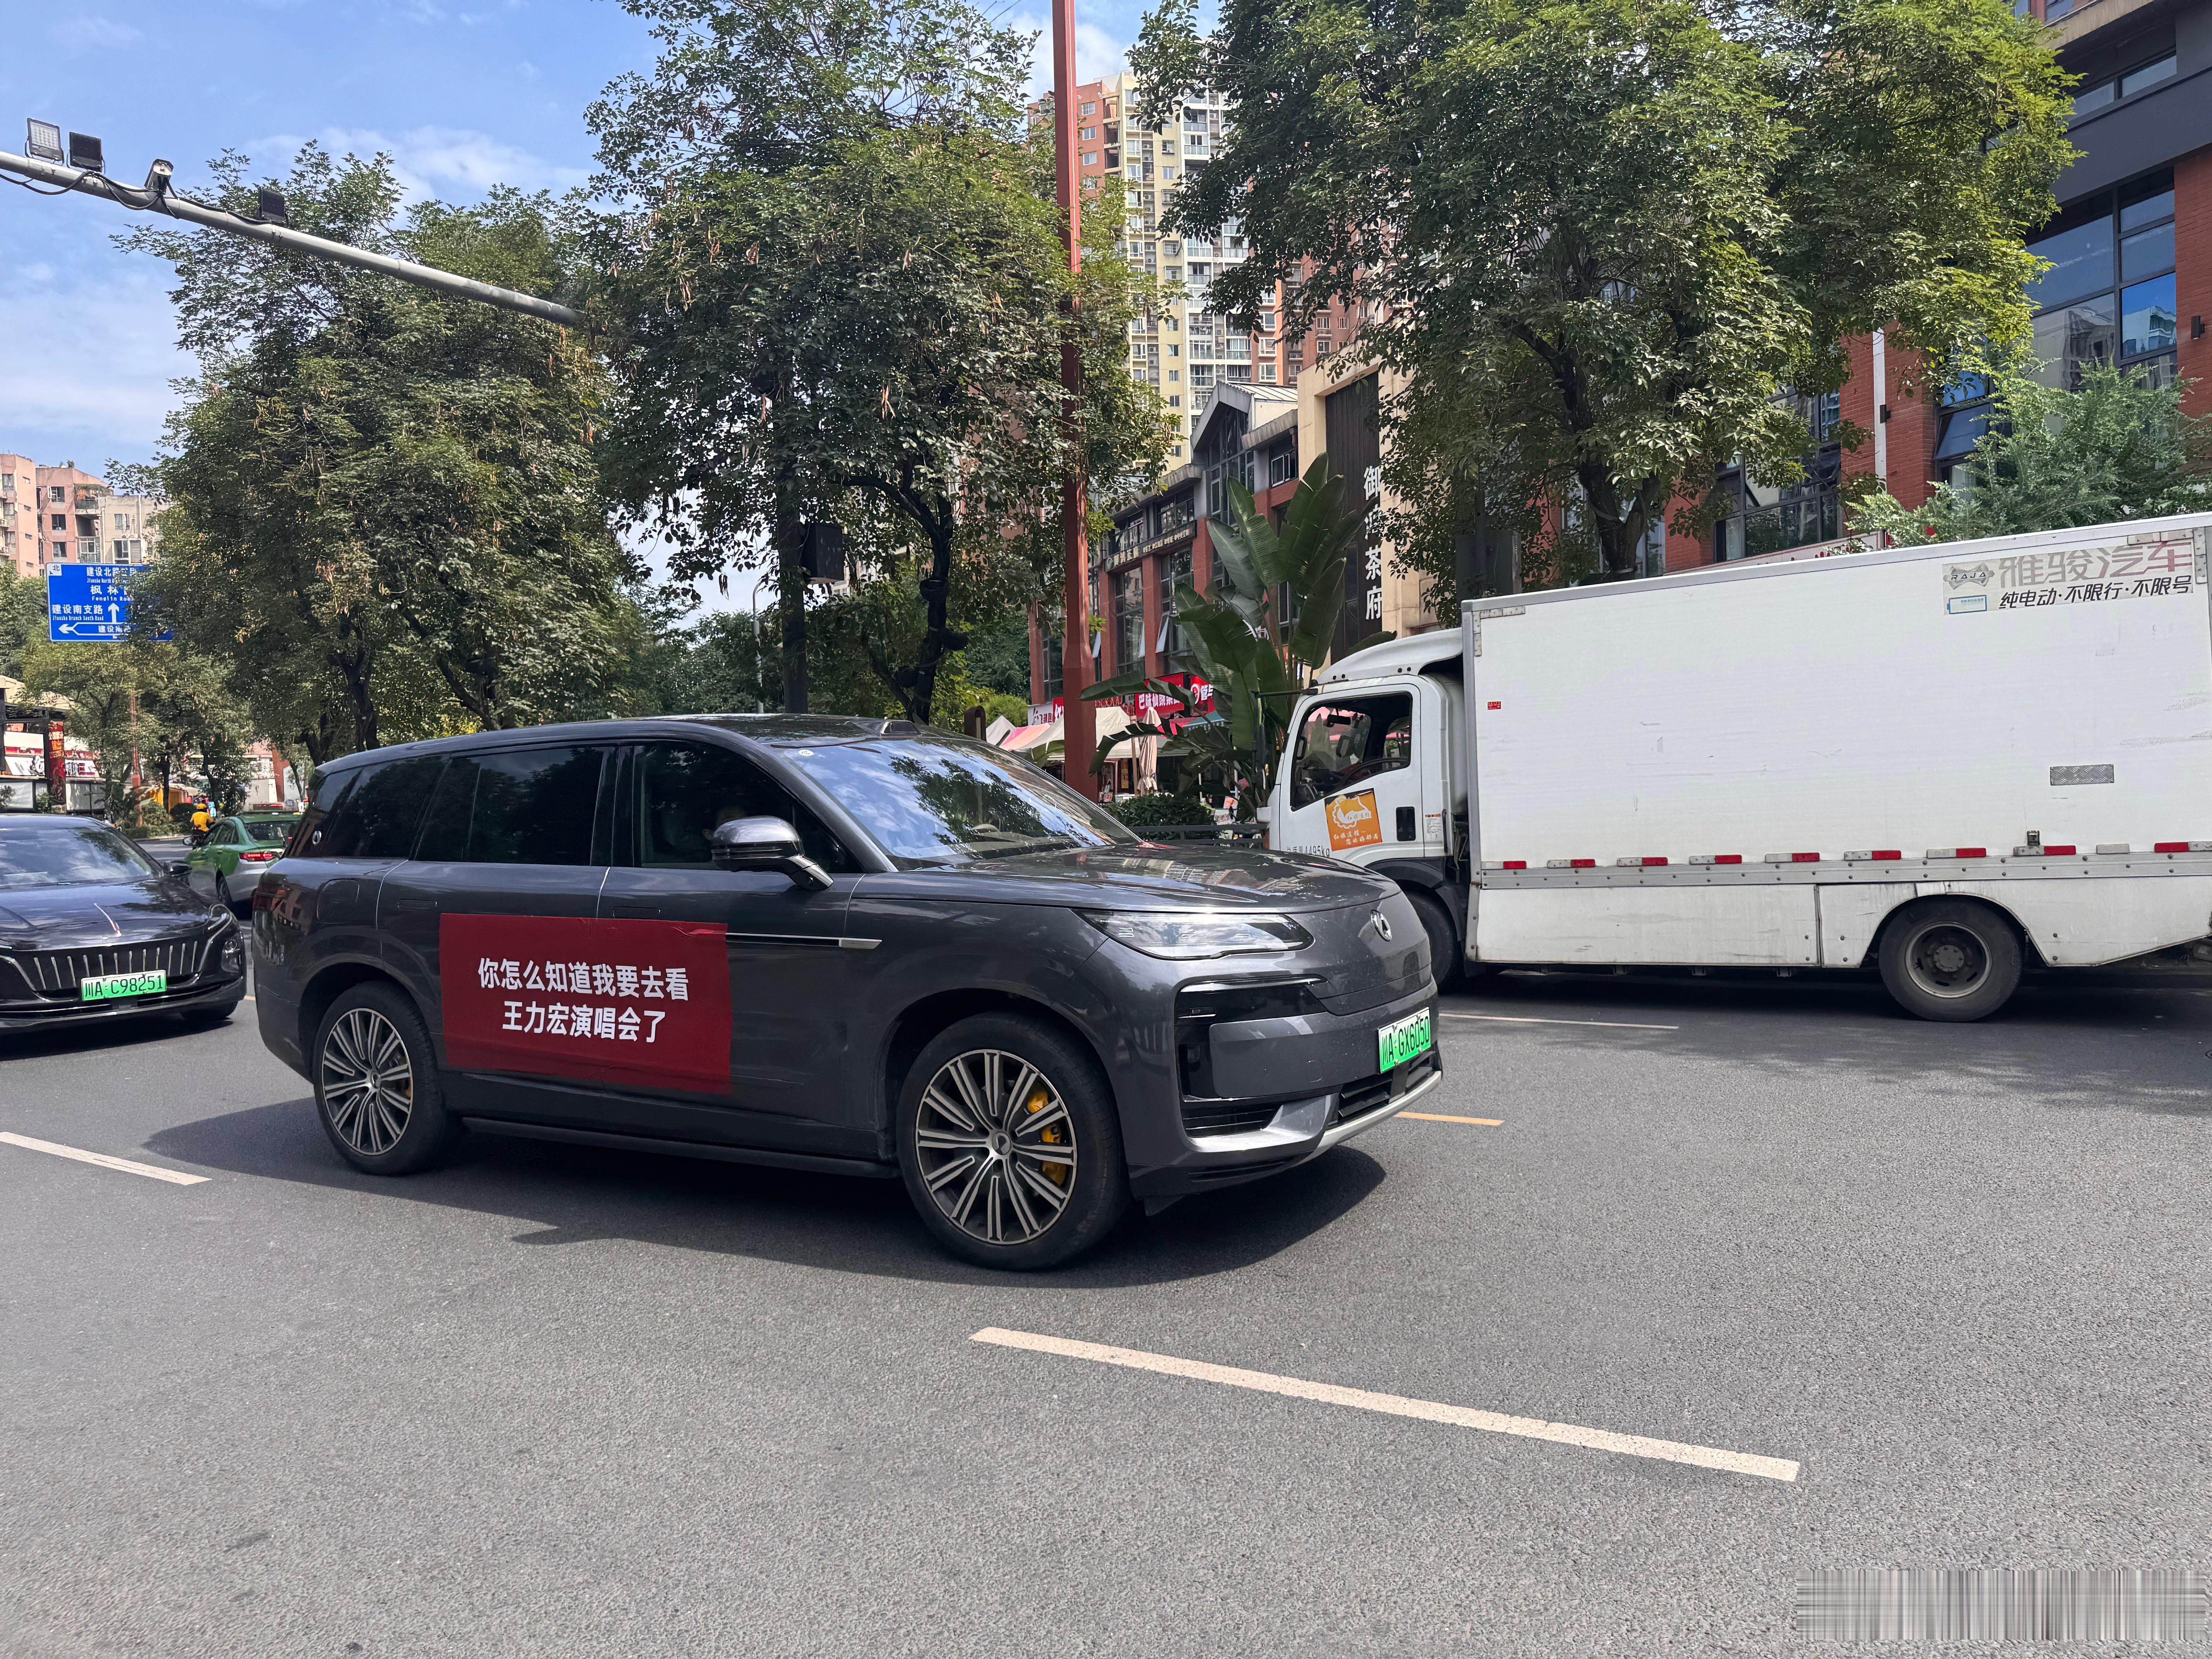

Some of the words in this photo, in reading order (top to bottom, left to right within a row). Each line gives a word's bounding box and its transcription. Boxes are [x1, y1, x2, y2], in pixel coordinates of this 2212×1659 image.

[1951, 572, 1986, 580] RAJA
[1998, 541, 2192, 588] 雅骏汽车
[52, 605, 103, 614] 建设南支路
[1999, 575, 2192, 609] 纯电动·不限行·不限号
[477, 958, 689, 1001] 你怎么知道我要去看
[502, 1000, 666, 1042] 王力宏演唱会了
